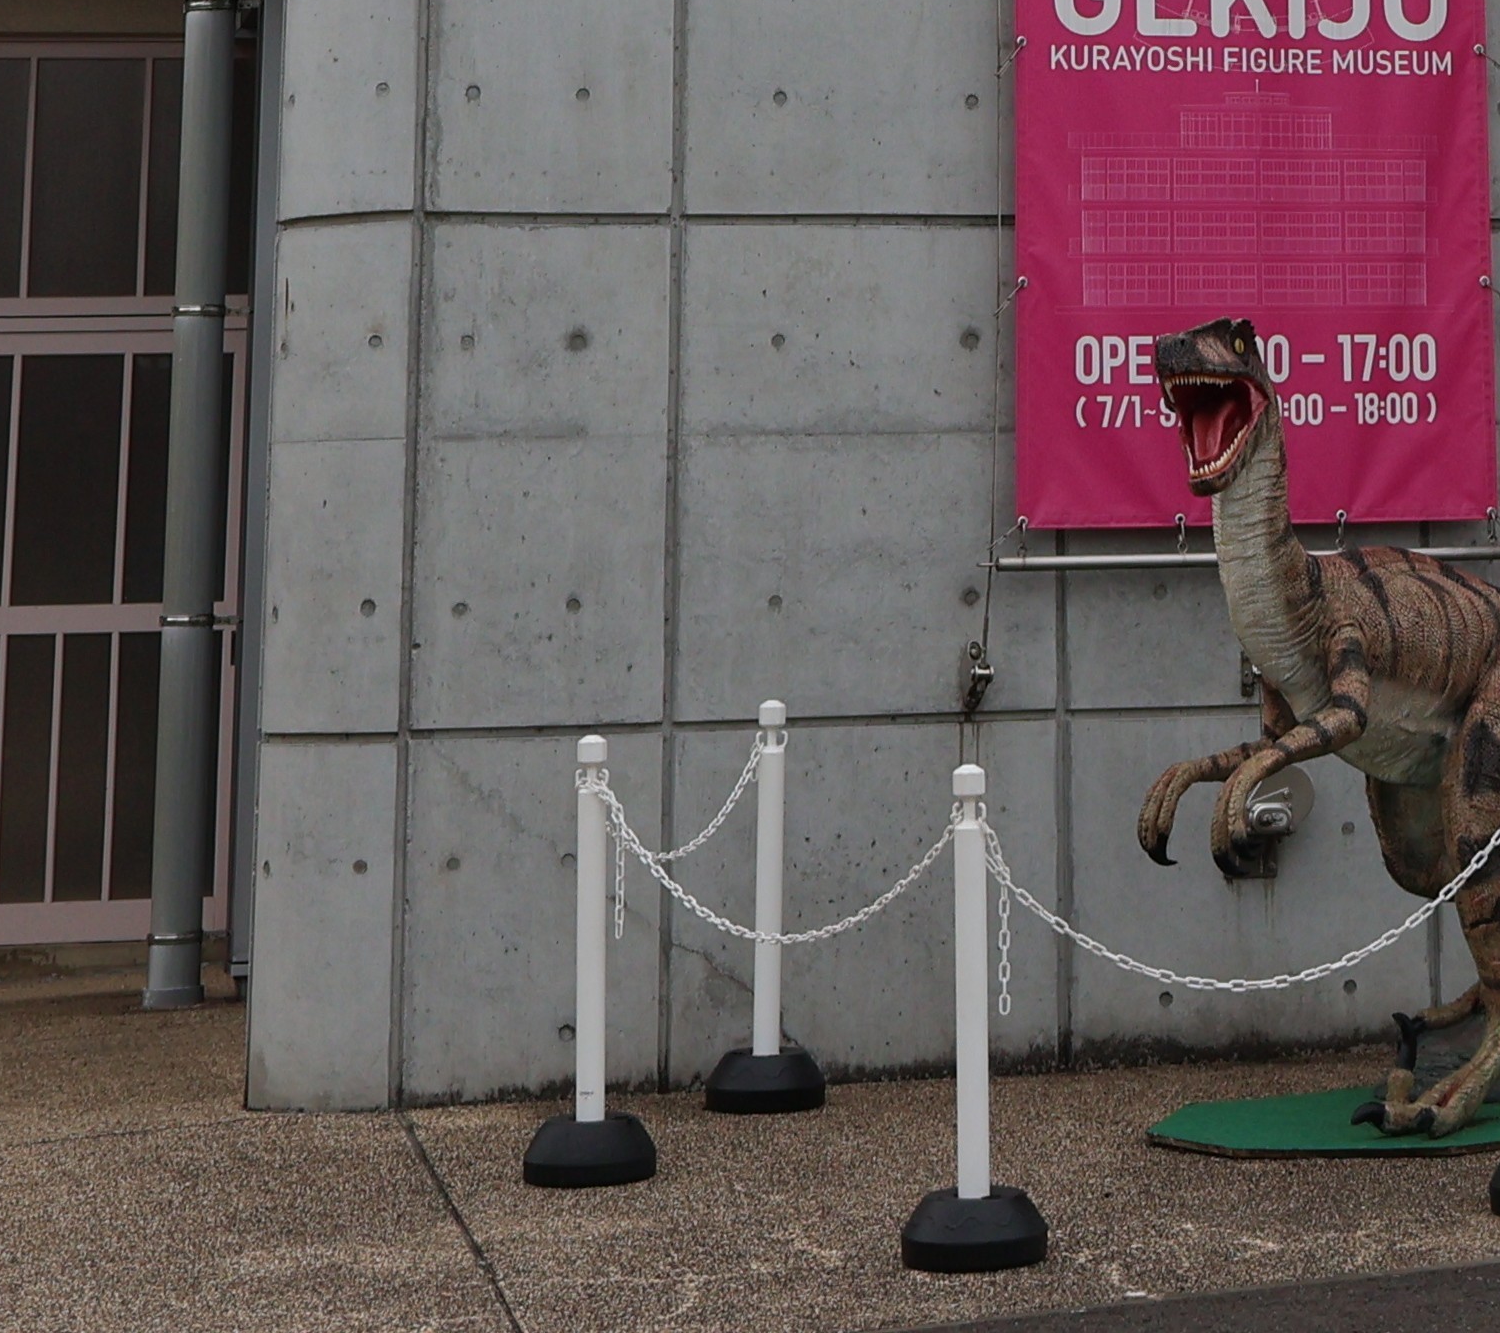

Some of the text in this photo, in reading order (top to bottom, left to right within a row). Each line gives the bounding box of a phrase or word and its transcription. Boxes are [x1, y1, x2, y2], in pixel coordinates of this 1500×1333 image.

[1050, 44, 1453, 76] KURAYOSHI FIGURE MUSEUM
[1075, 335, 1158, 385] OPE
[1337, 333, 1437, 383] 17:00
[1355, 392, 1418, 426] 18:00
